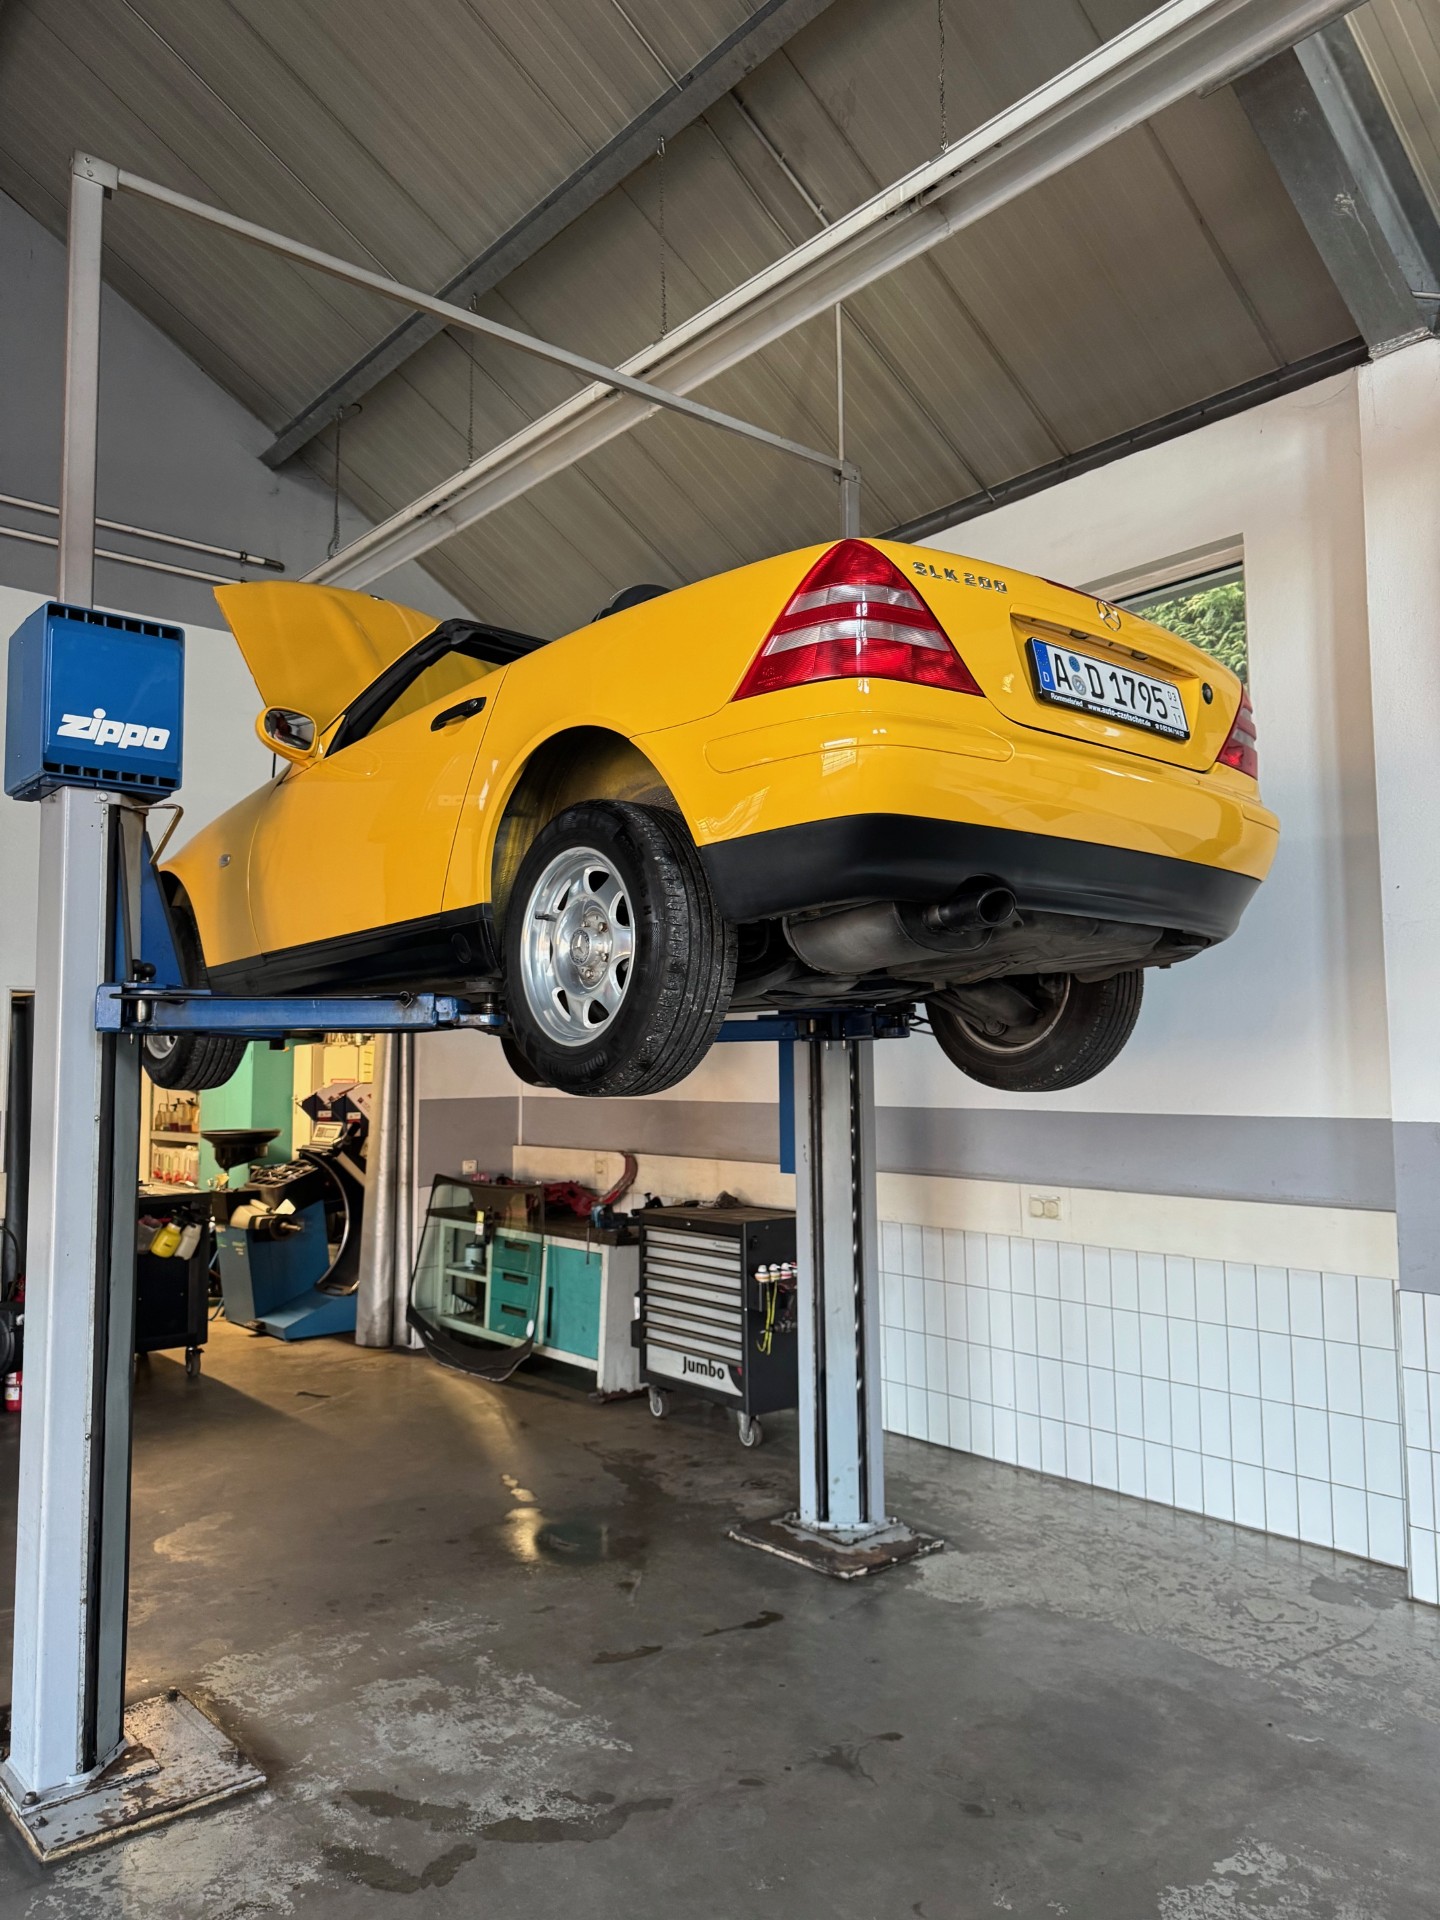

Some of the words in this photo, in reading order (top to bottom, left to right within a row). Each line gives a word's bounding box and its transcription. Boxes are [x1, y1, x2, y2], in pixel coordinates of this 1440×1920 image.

[913, 562, 960, 583] SLK
[963, 572, 1008, 594] 200
[1042, 671, 1050, 683] D
[1054, 653, 1073, 691] A
[1084, 663, 1105, 699] D
[1109, 671, 1168, 719] 1795
[57, 708, 171, 750] zippo
[683, 1356, 725, 1380] Jumbo
